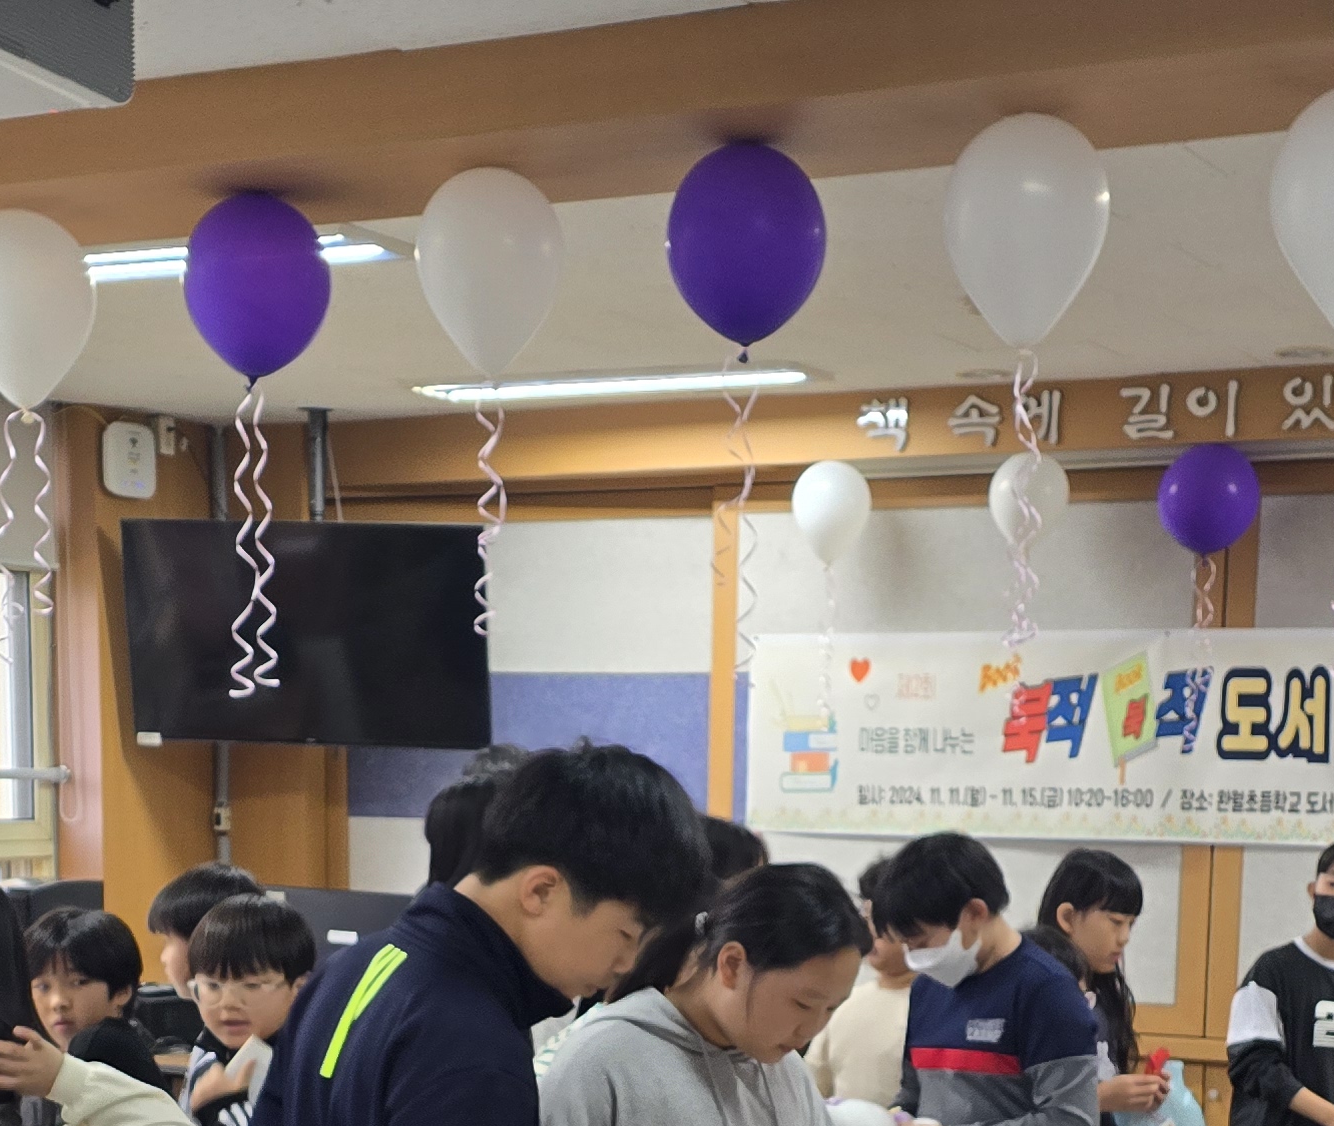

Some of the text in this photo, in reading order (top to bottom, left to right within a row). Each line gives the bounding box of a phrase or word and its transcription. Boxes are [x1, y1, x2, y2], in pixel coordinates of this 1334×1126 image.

[858, 398, 909, 451] 책
[948, 389, 1061, 446] 속에
[1120, 380, 1238, 439] 길이
[1217, 665, 1330, 763] 도서
[859, 726, 974, 755] 마음을 함께 나누는
[1180, 791, 1214, 812] 장소:
